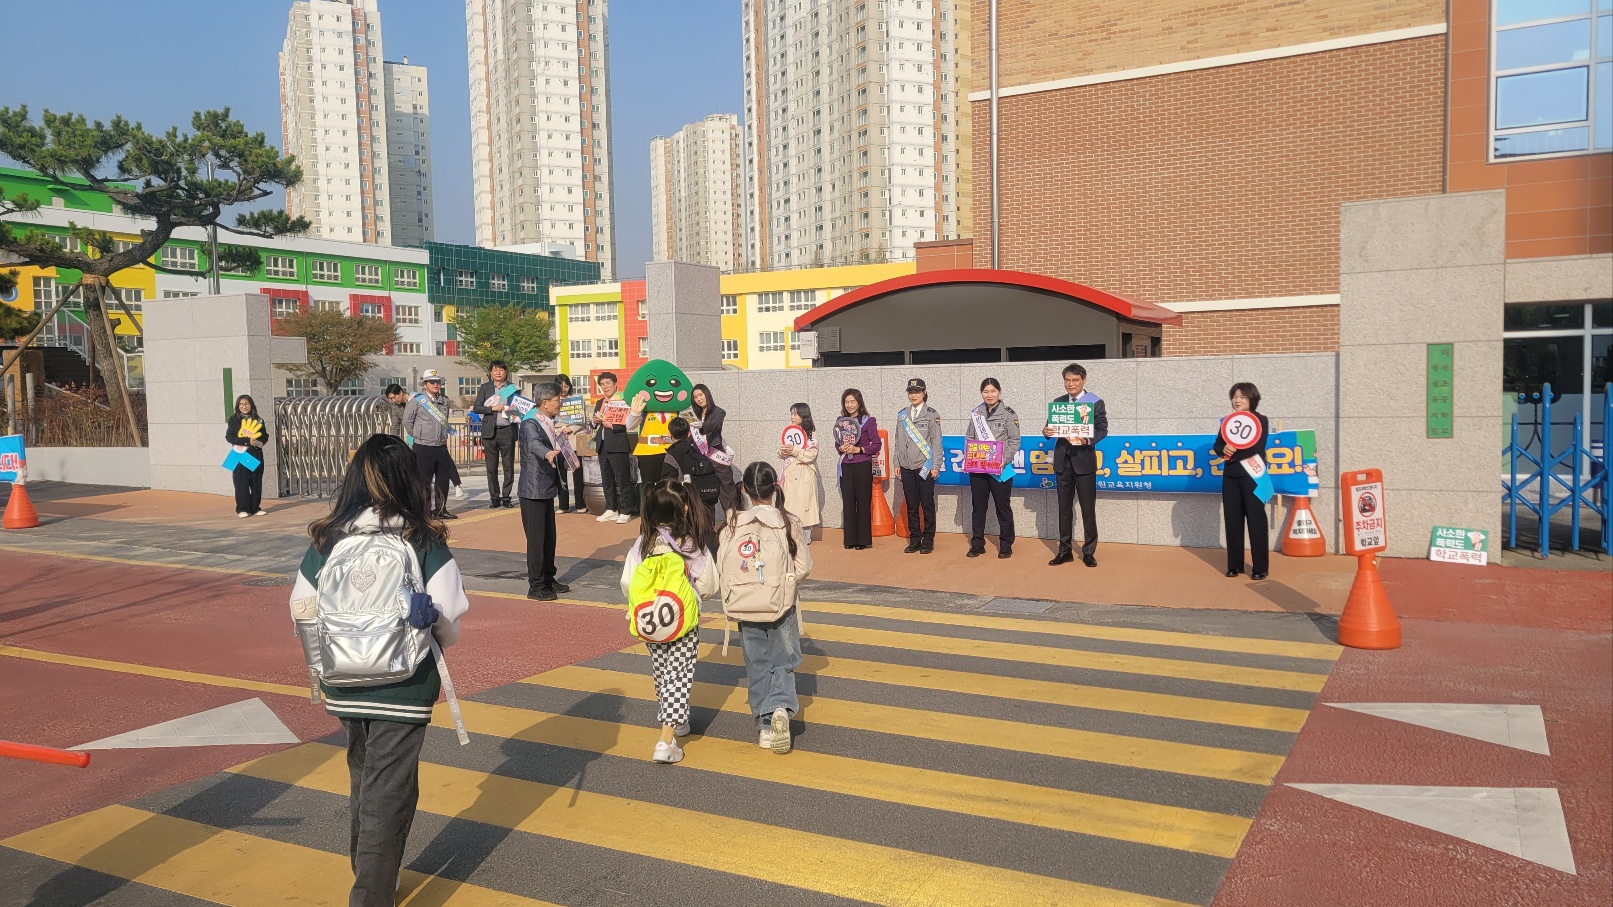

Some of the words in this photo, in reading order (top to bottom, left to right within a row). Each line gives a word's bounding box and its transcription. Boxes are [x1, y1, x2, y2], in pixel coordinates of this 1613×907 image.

[1051, 404, 1075, 414] 사소한
[606, 413, 625, 423] 공범
[1051, 414, 1075, 424] 폭력도
[1052, 425, 1090, 436] 학교폭력
[1230, 420, 1252, 439] 30
[787, 433, 801, 446] 30
[1116, 449, 1203, 478] 살피고,
[1355, 518, 1383, 532] 주차금지
[1436, 528, 1465, 539] 사소한
[1360, 536, 1379, 547] 학교앞
[1435, 538, 1464, 549] 폭력도
[1435, 549, 1482, 563] 학교폭력
[640, 602, 675, 635] 30
[456, 720, 465, 734] MLB
